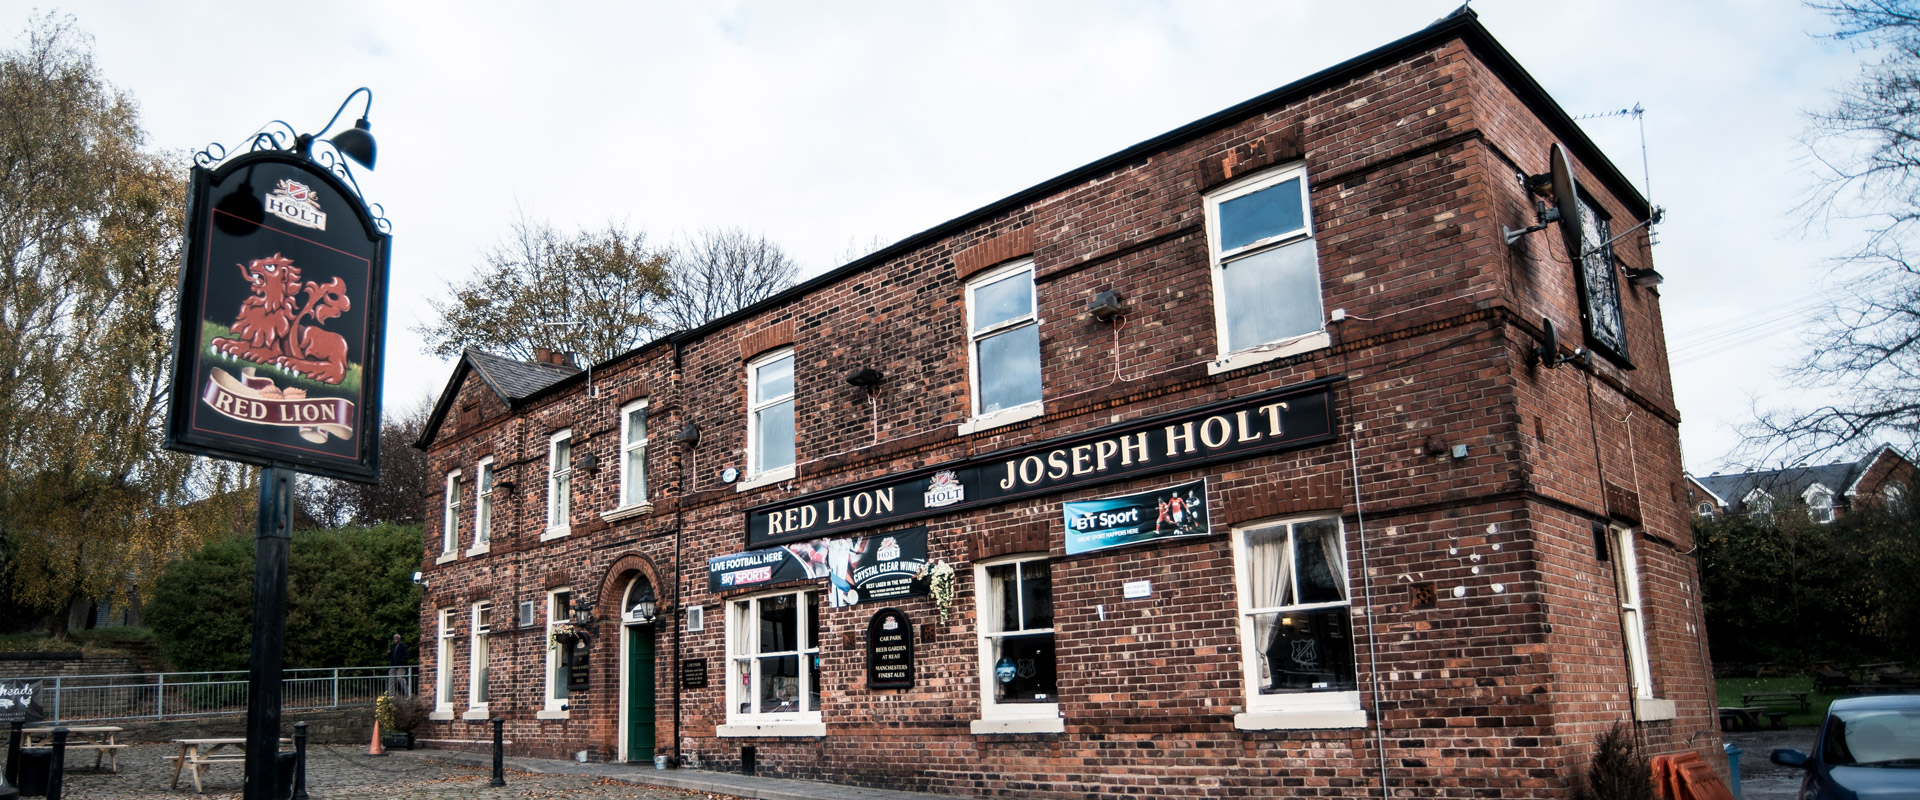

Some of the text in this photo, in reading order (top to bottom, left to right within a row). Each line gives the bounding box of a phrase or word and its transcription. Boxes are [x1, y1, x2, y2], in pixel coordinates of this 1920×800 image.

[269, 199, 323, 225] HOLT
[215, 391, 336, 421] RED LION
[1000, 402, 1289, 490] JOSEPH HOLT
[927, 488, 962, 504] HOLT
[768, 487, 895, 535] RED LION
[1076, 508, 1138, 530] BT Sport
[1105, 530, 1127, 538] HAPPENS
[711, 551, 783, 572] LIVE FOOTBALL HERE
[878, 550, 898, 559] HOLT
[721, 568, 770, 586] sky SPORTS
[853, 561, 923, 583] CRYSTAL CLEAR WINNE
